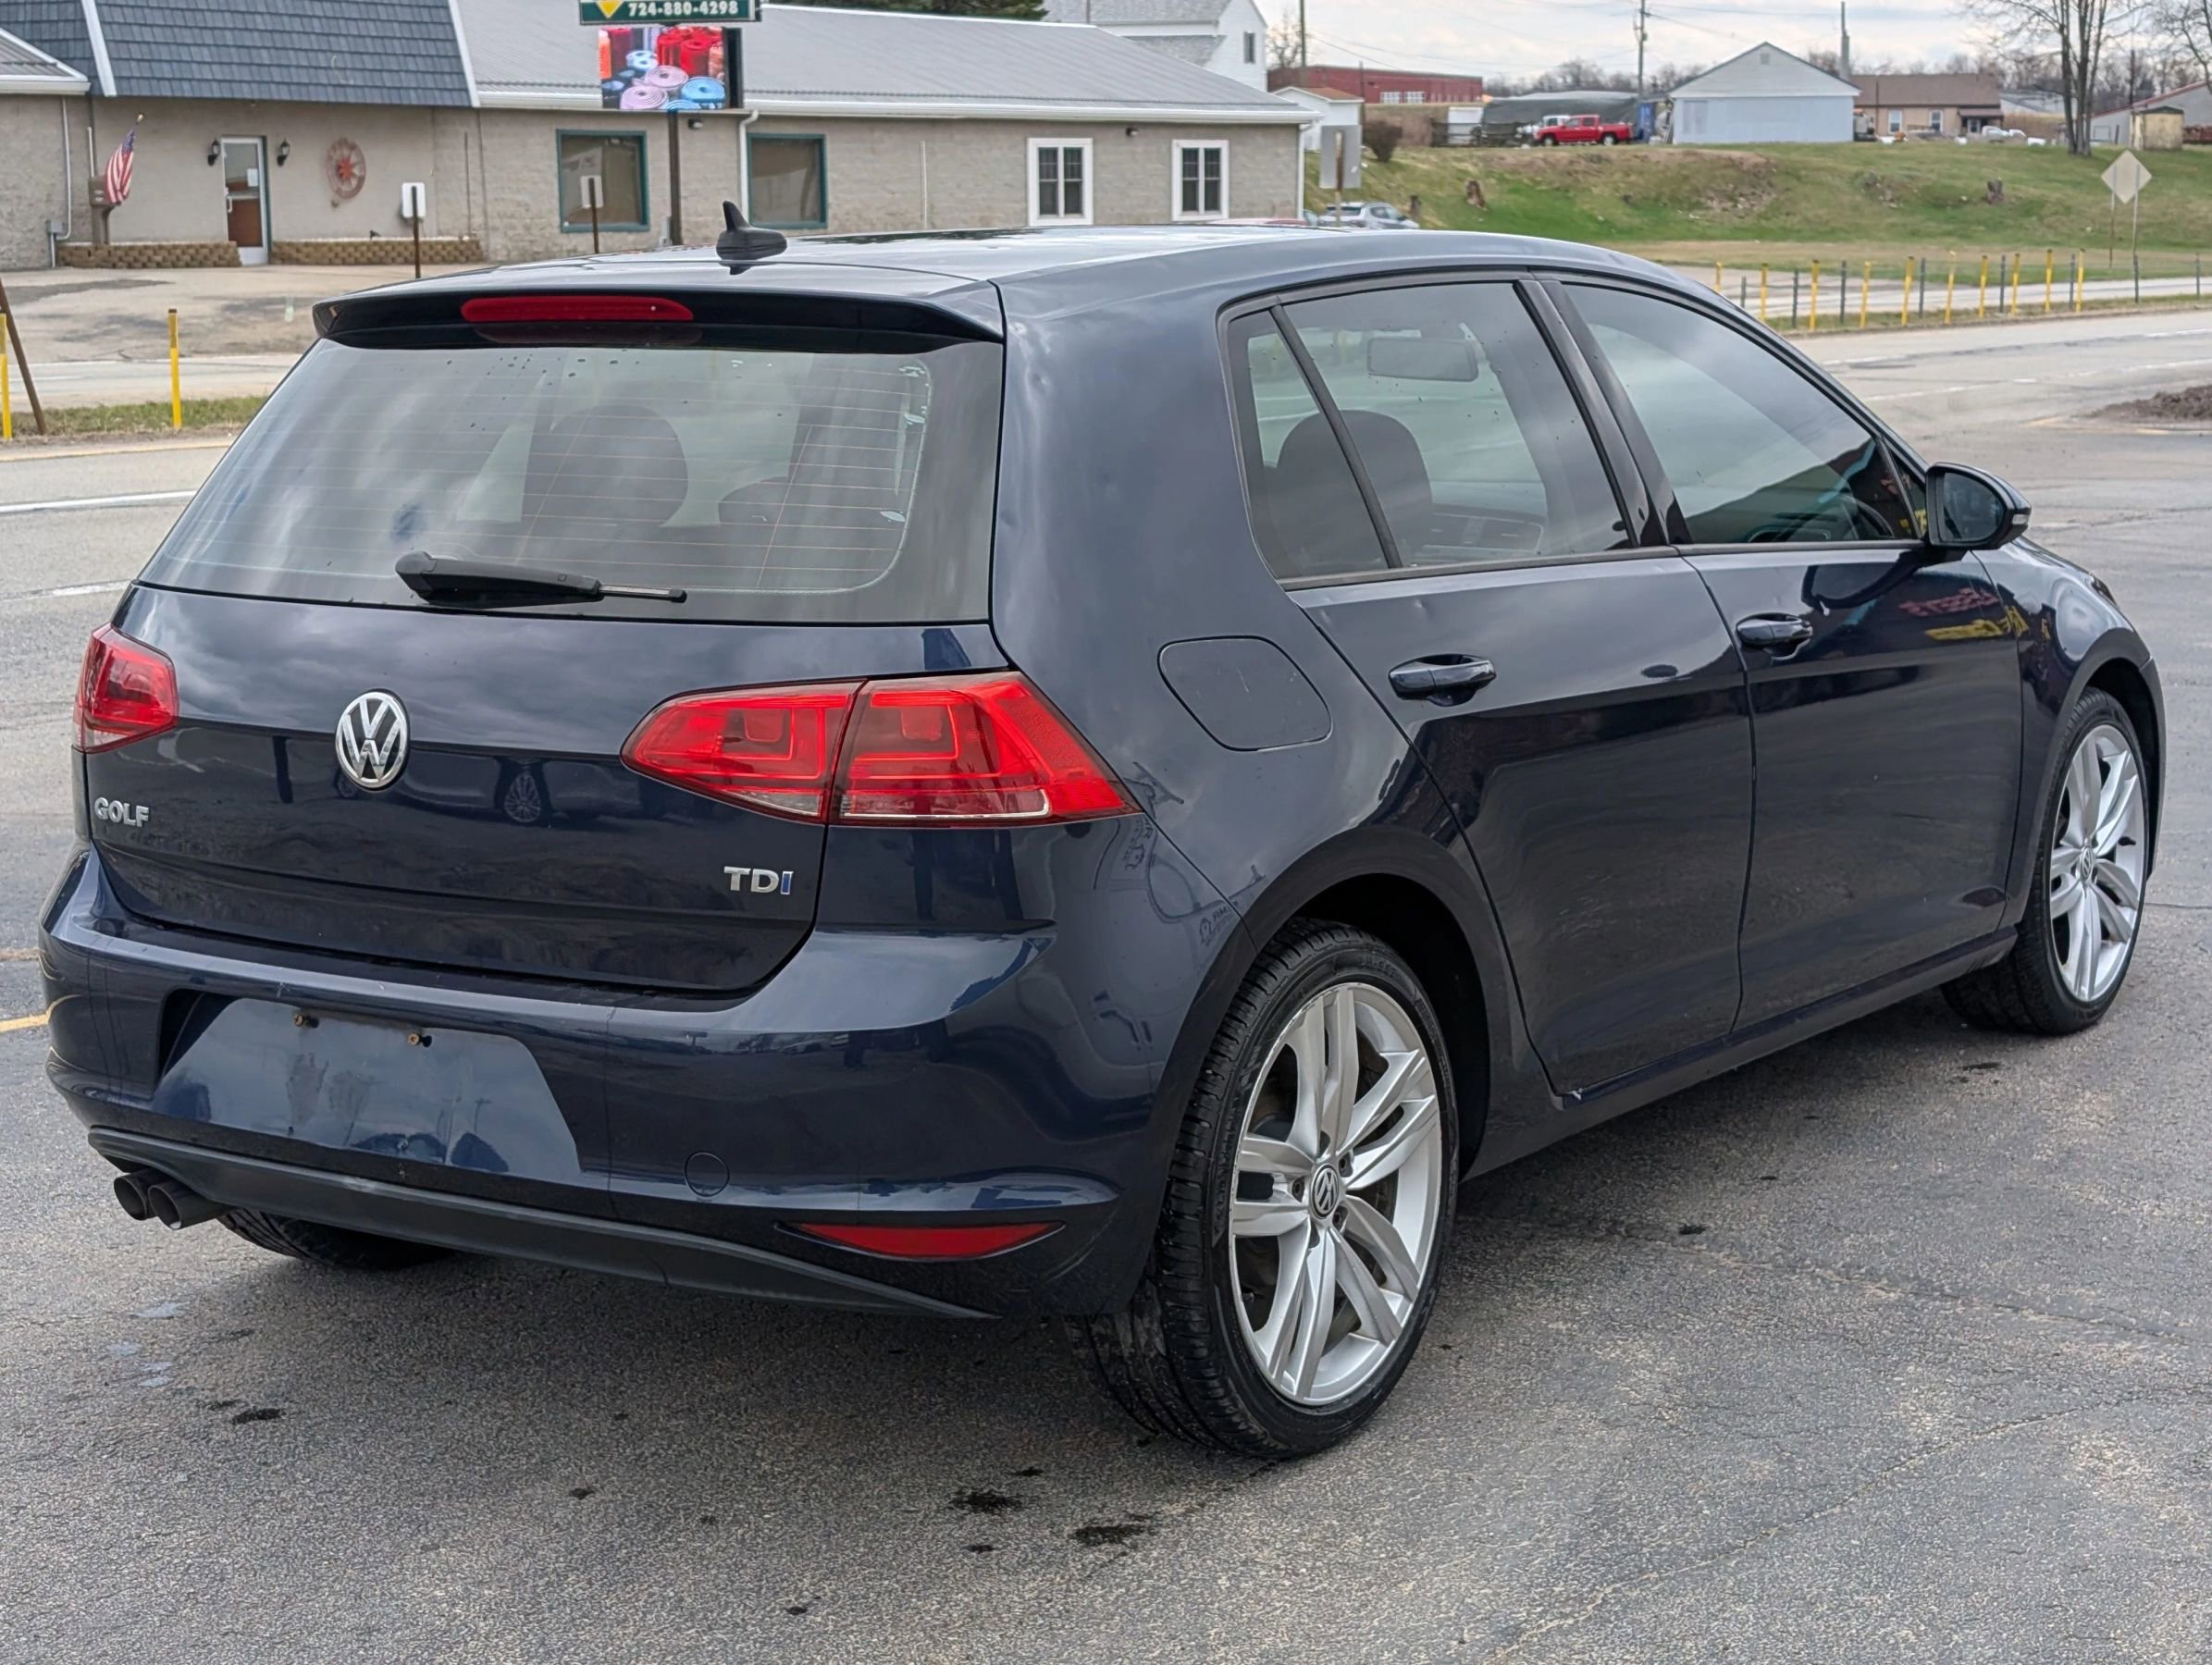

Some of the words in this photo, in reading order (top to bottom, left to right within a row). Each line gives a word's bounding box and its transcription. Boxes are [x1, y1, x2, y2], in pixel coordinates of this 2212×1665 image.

[628, 1, 739, 17] 724-880-4298
[93, 796, 150, 827] GOLF
[723, 866, 794, 895] TDI
